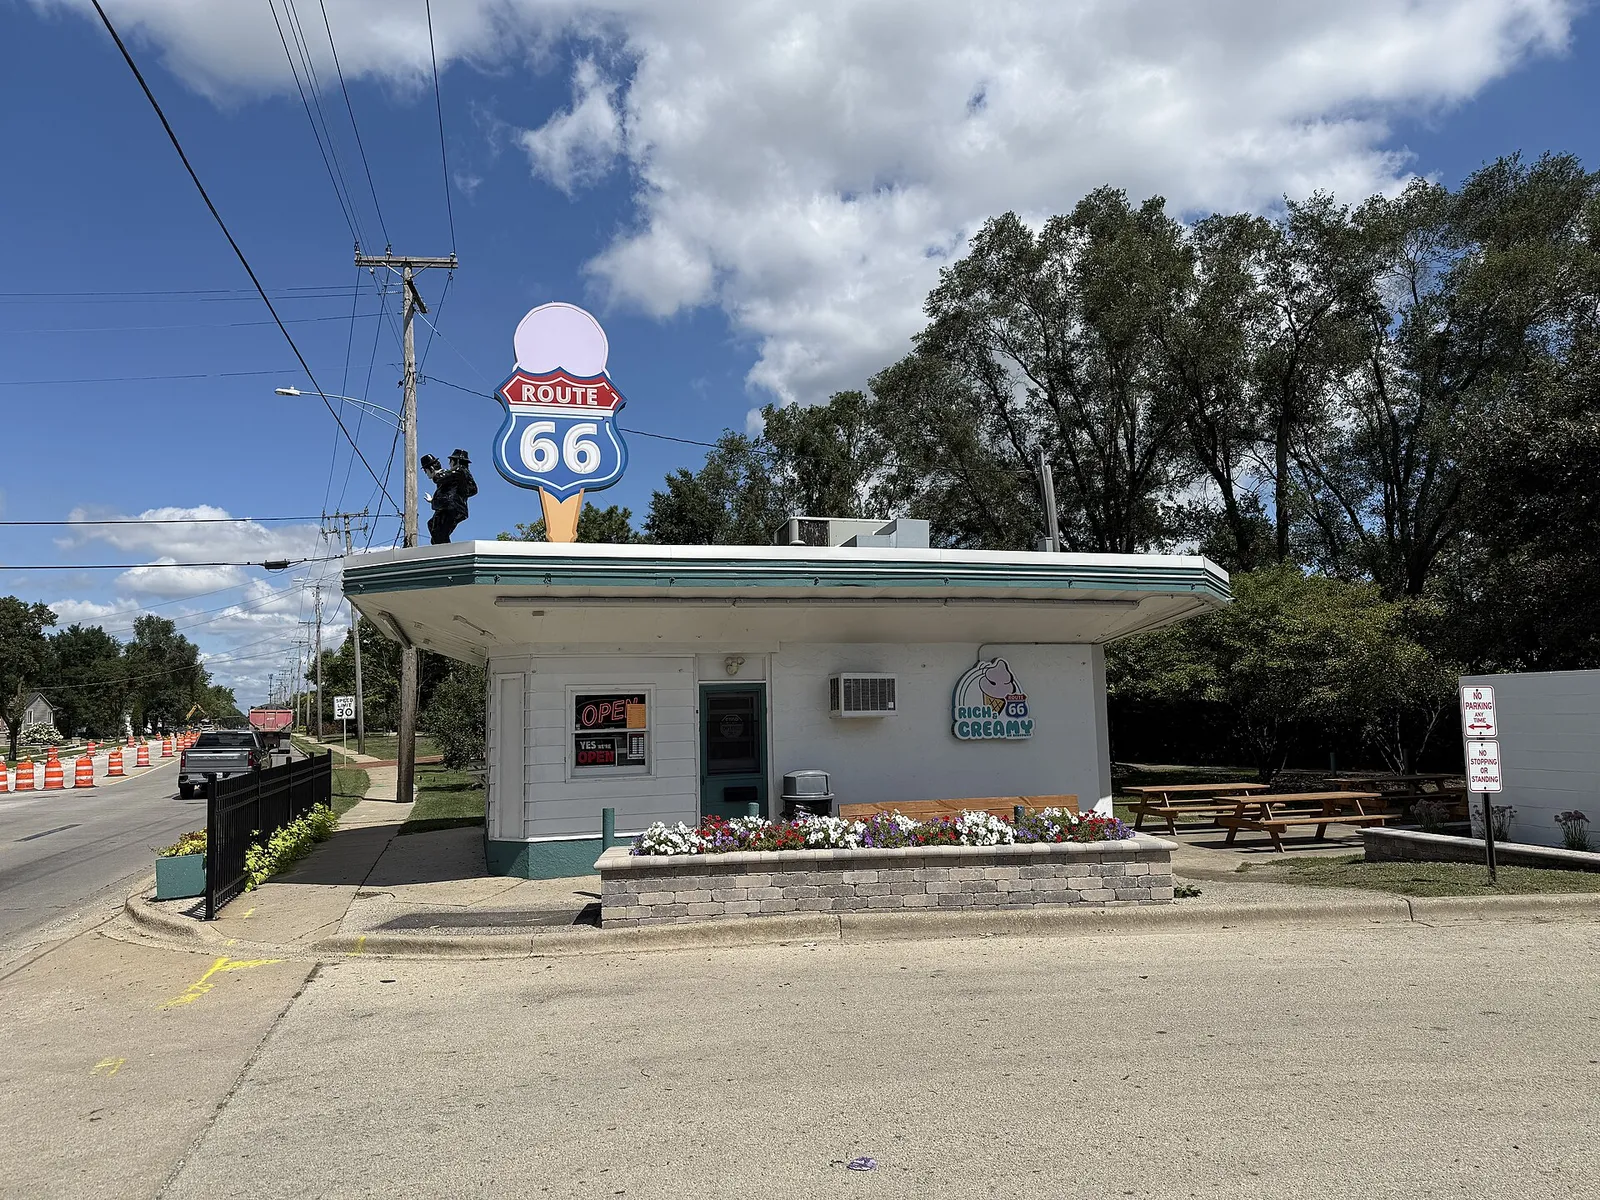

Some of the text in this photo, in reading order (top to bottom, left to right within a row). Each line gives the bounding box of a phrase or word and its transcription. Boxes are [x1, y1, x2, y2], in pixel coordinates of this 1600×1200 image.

[521, 384, 599, 406] ROUTE
[519, 421, 602, 475] 66
[1472, 692, 1483, 700] NO
[1008, 704, 1024, 716] 66
[1465, 702, 1492, 710] PARKING
[337, 708, 353, 717] 30
[958, 706, 992, 719] RICH
[958, 720, 1033, 737] CREAMY
[580, 741, 596, 750] YES
[578, 751, 614, 763] OPEN
